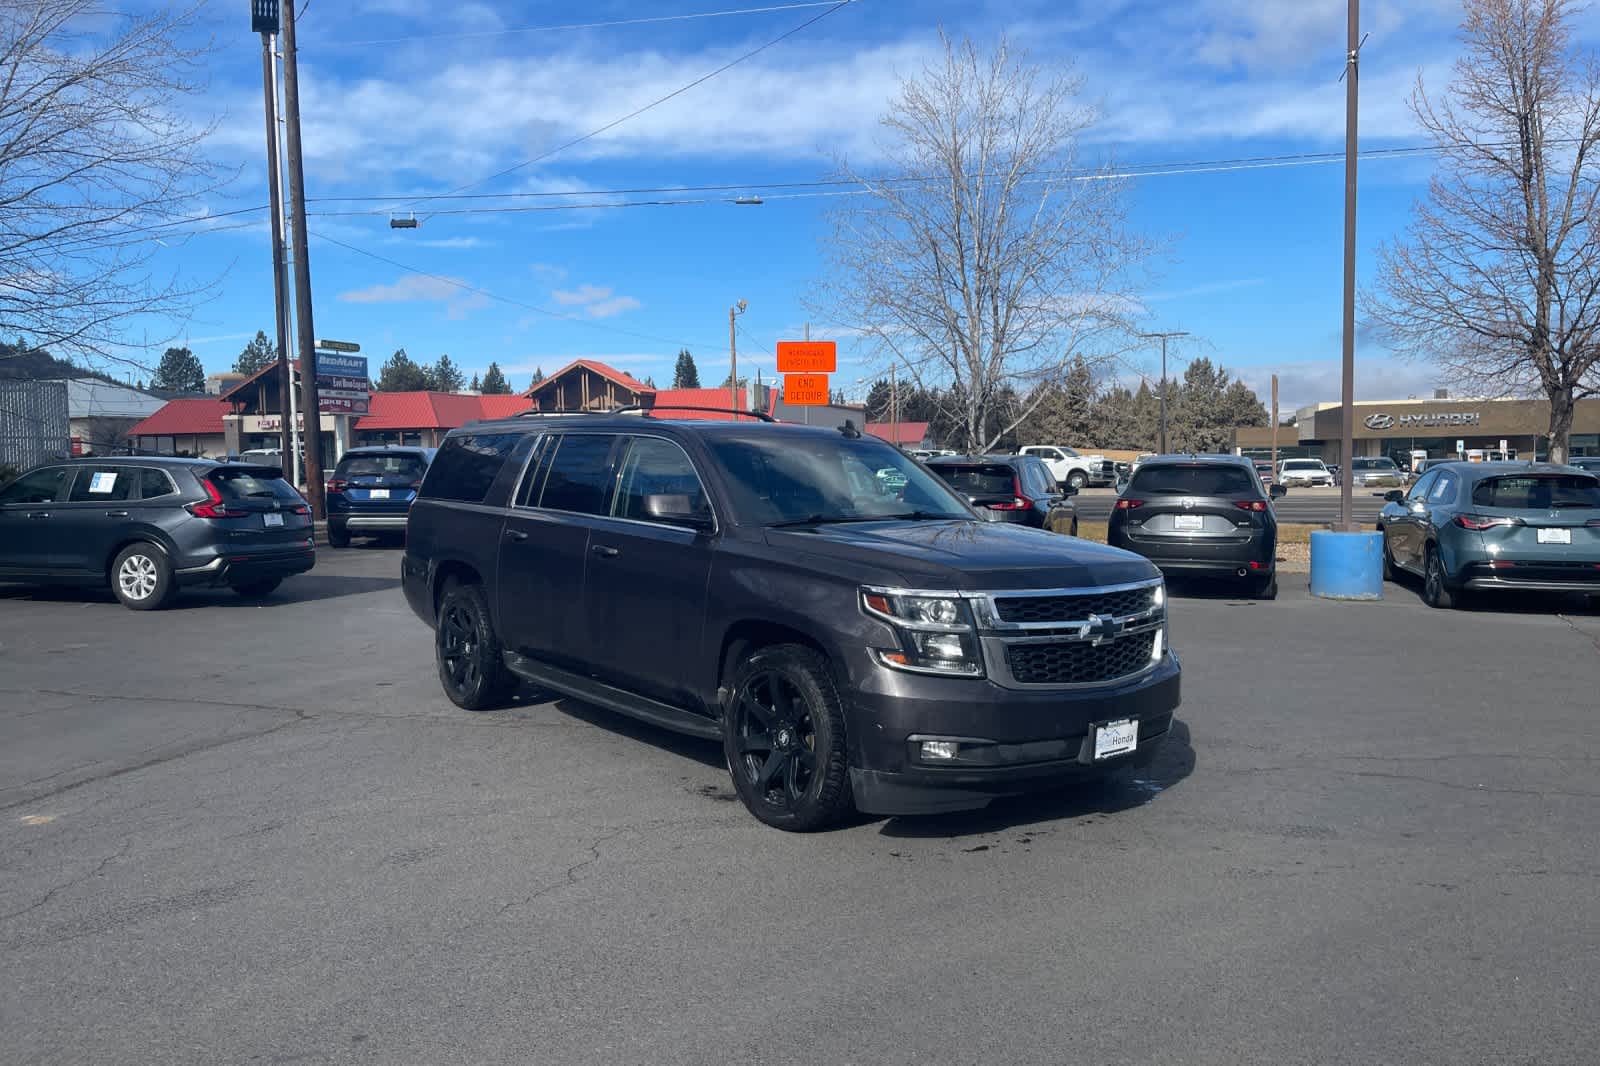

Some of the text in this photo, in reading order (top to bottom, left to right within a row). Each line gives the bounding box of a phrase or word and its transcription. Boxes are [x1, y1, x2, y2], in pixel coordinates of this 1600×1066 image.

[798, 378, 815, 388] END
[790, 391, 823, 401] DETOUR
[1399, 411, 1480, 428] HYUNDAI
[1112, 735, 1134, 745] Honda
